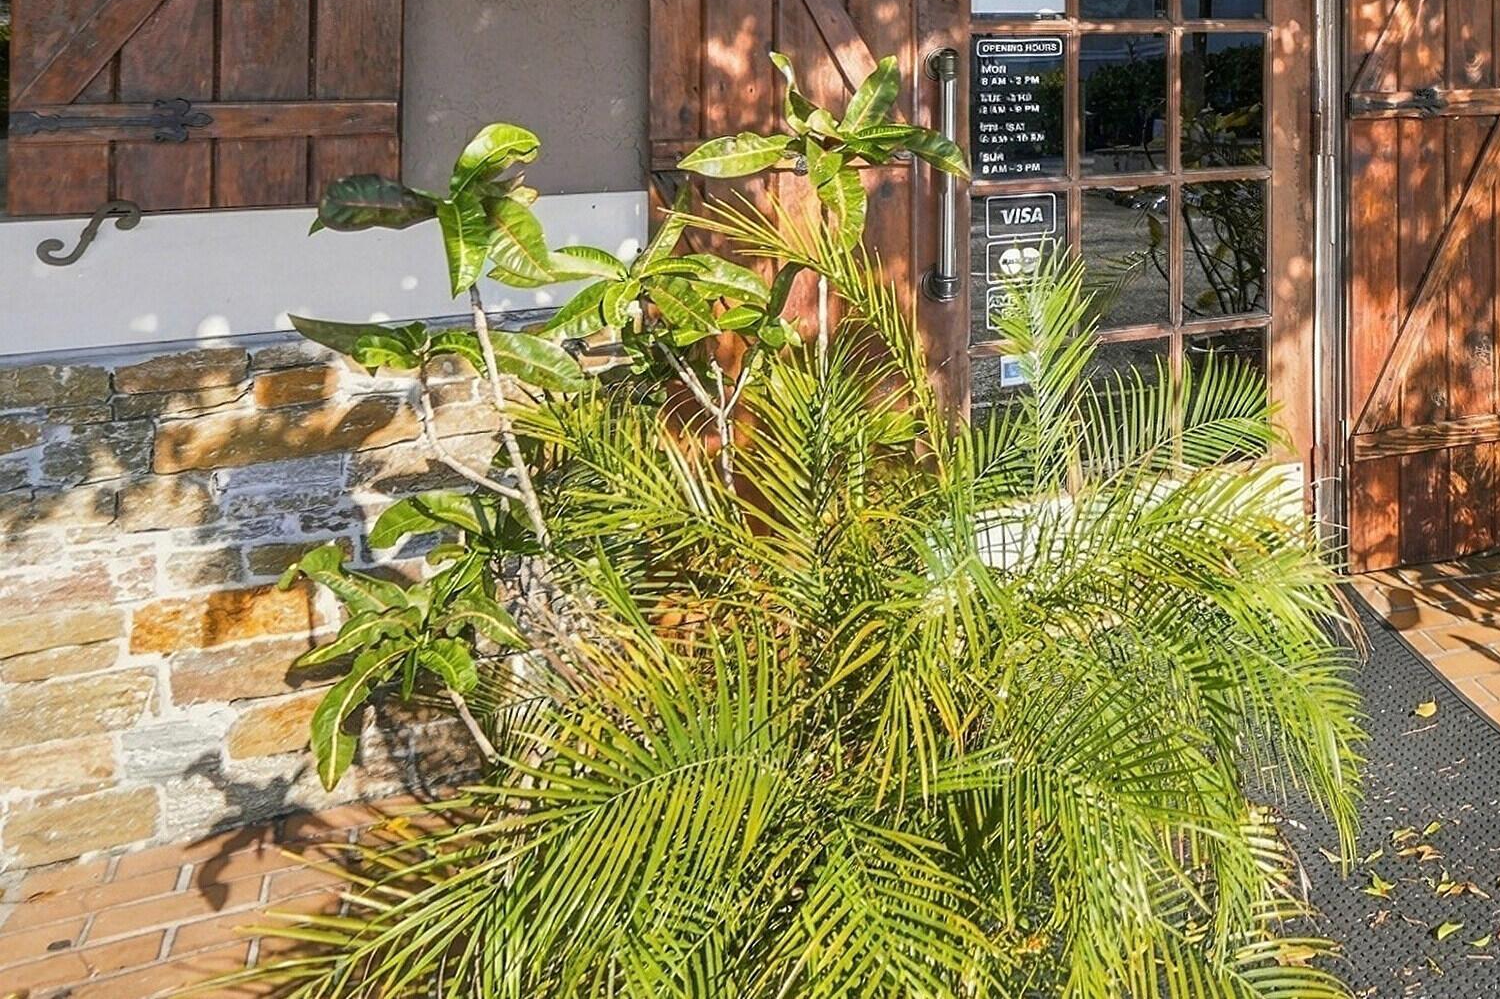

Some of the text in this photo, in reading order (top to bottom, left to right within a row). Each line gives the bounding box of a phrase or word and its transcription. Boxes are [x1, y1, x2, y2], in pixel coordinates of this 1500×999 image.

[982, 43, 1057, 52] OPENING HOURS
[981, 65, 1007, 74] MON
[981, 77, 988, 85] 8
[991, 77, 1007, 85] AM
[1015, 77, 1022, 85] 3
[1024, 76, 1040, 84] PM
[990, 105, 1006, 114] AM
[1024, 104, 1040, 113] PM
[1006, 122, 1025, 132] SAT
[981, 152, 1004, 162] SUN
[982, 165, 989, 174] 8
[991, 164, 1007, 173] AM
[1016, 164, 1023, 172] 3
[1025, 163, 1041, 172] PM
[1000, 207, 1044, 225] VISA
